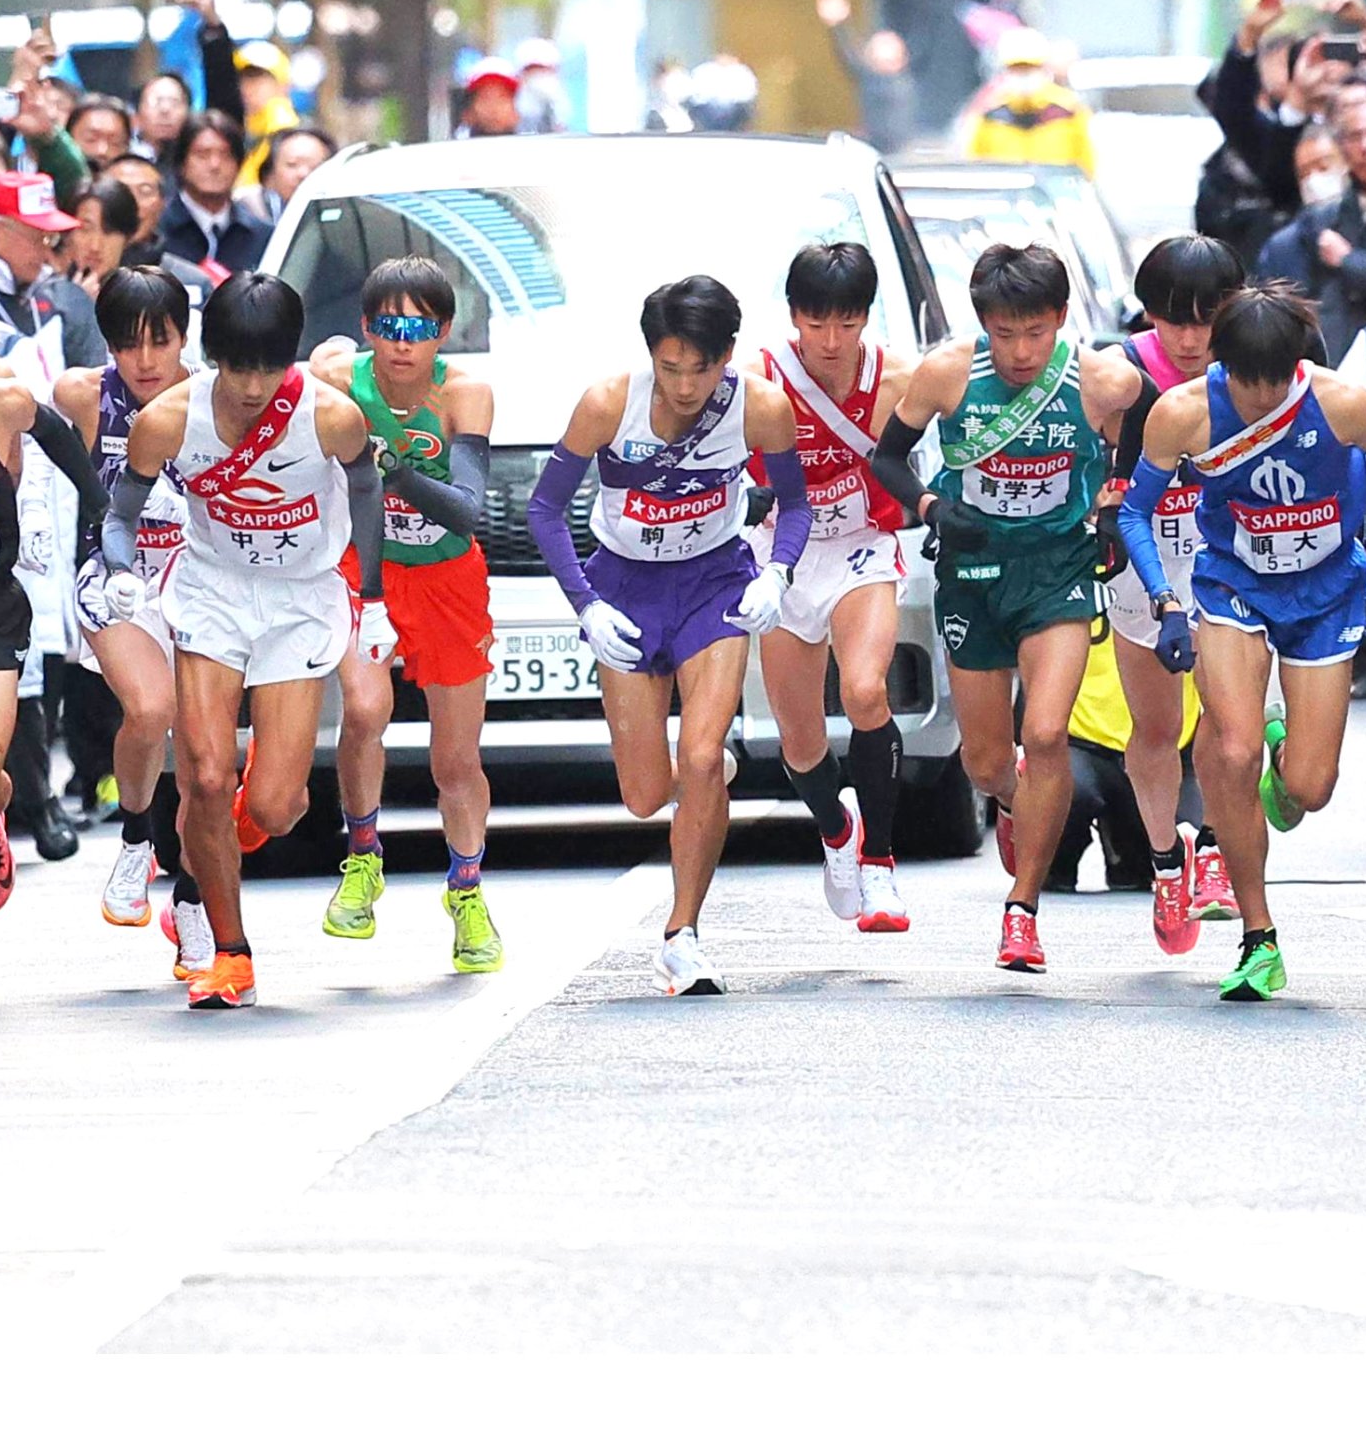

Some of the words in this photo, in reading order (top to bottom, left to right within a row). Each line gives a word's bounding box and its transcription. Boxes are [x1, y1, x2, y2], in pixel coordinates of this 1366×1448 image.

[960, 415, 1078, 449] 青学院
[199, 422, 276, 494] 中央大学
[629, 442, 656, 457] HRS
[988, 455, 1069, 476] SAPPORO
[978, 474, 1053, 500] 青学大
[231, 501, 314, 527] SAPPORO
[646, 492, 722, 521] SAPPORO
[998, 501, 1032, 515] 3-1
[1251, 504, 1335, 530] SAPPORO
[640, 520, 706, 545] 駒大
[1160, 518, 1180, 539] 日
[231, 531, 299, 550] 中大
[1172, 538, 1194, 556] 15
[1251, 531, 1318, 555] 順大
[249, 550, 284, 565] 2-1
[1267, 556, 1303, 571] 5-1
[546, 634, 580, 653] 300
